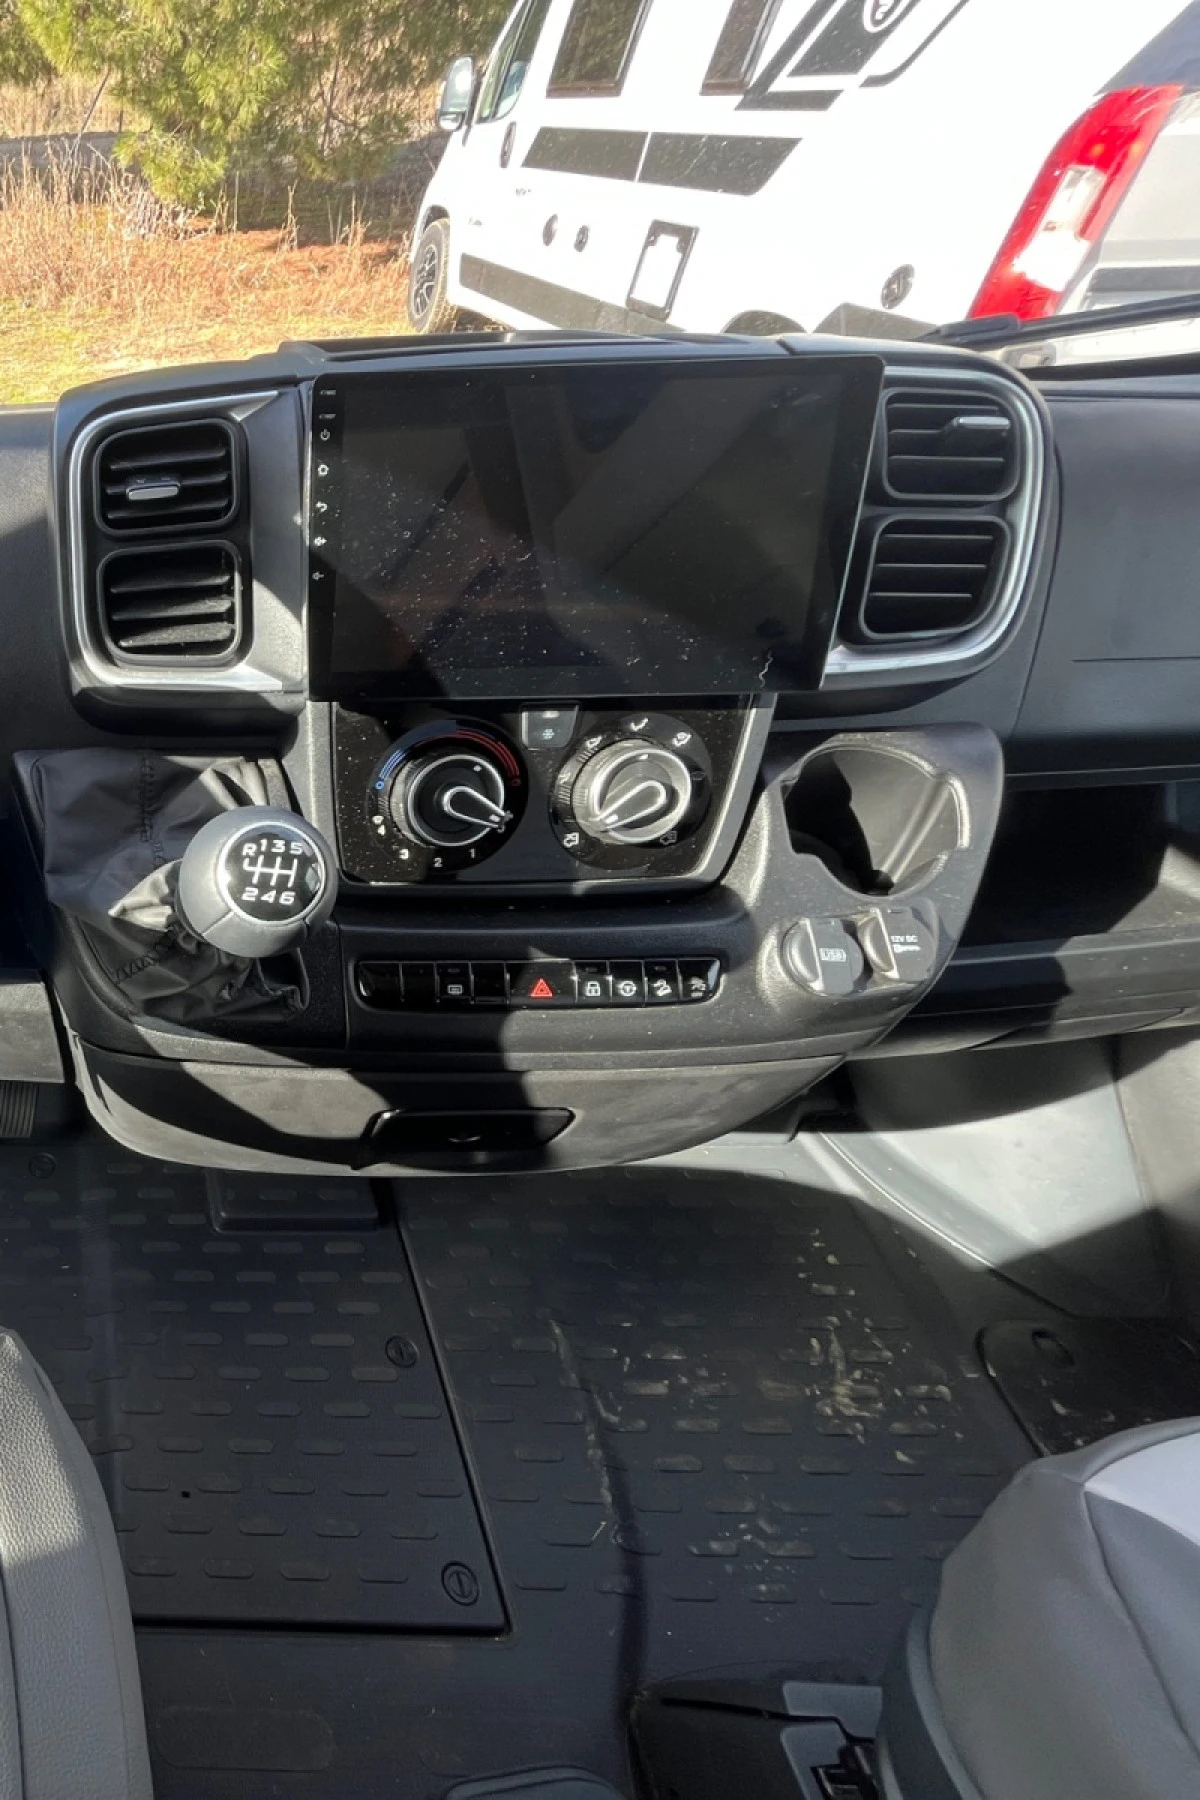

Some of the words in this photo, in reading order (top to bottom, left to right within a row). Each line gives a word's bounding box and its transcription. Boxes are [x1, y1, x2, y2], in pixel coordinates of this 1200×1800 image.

[242, 843, 257, 856] R
[260, 838, 268, 852] 1
[271, 839, 286, 853] 3
[290, 842, 304, 855] 5
[434, 857, 443, 868] 2
[242, 887, 259, 901] 2
[260, 889, 277, 904] 4
[279, 891, 296, 905] 6
